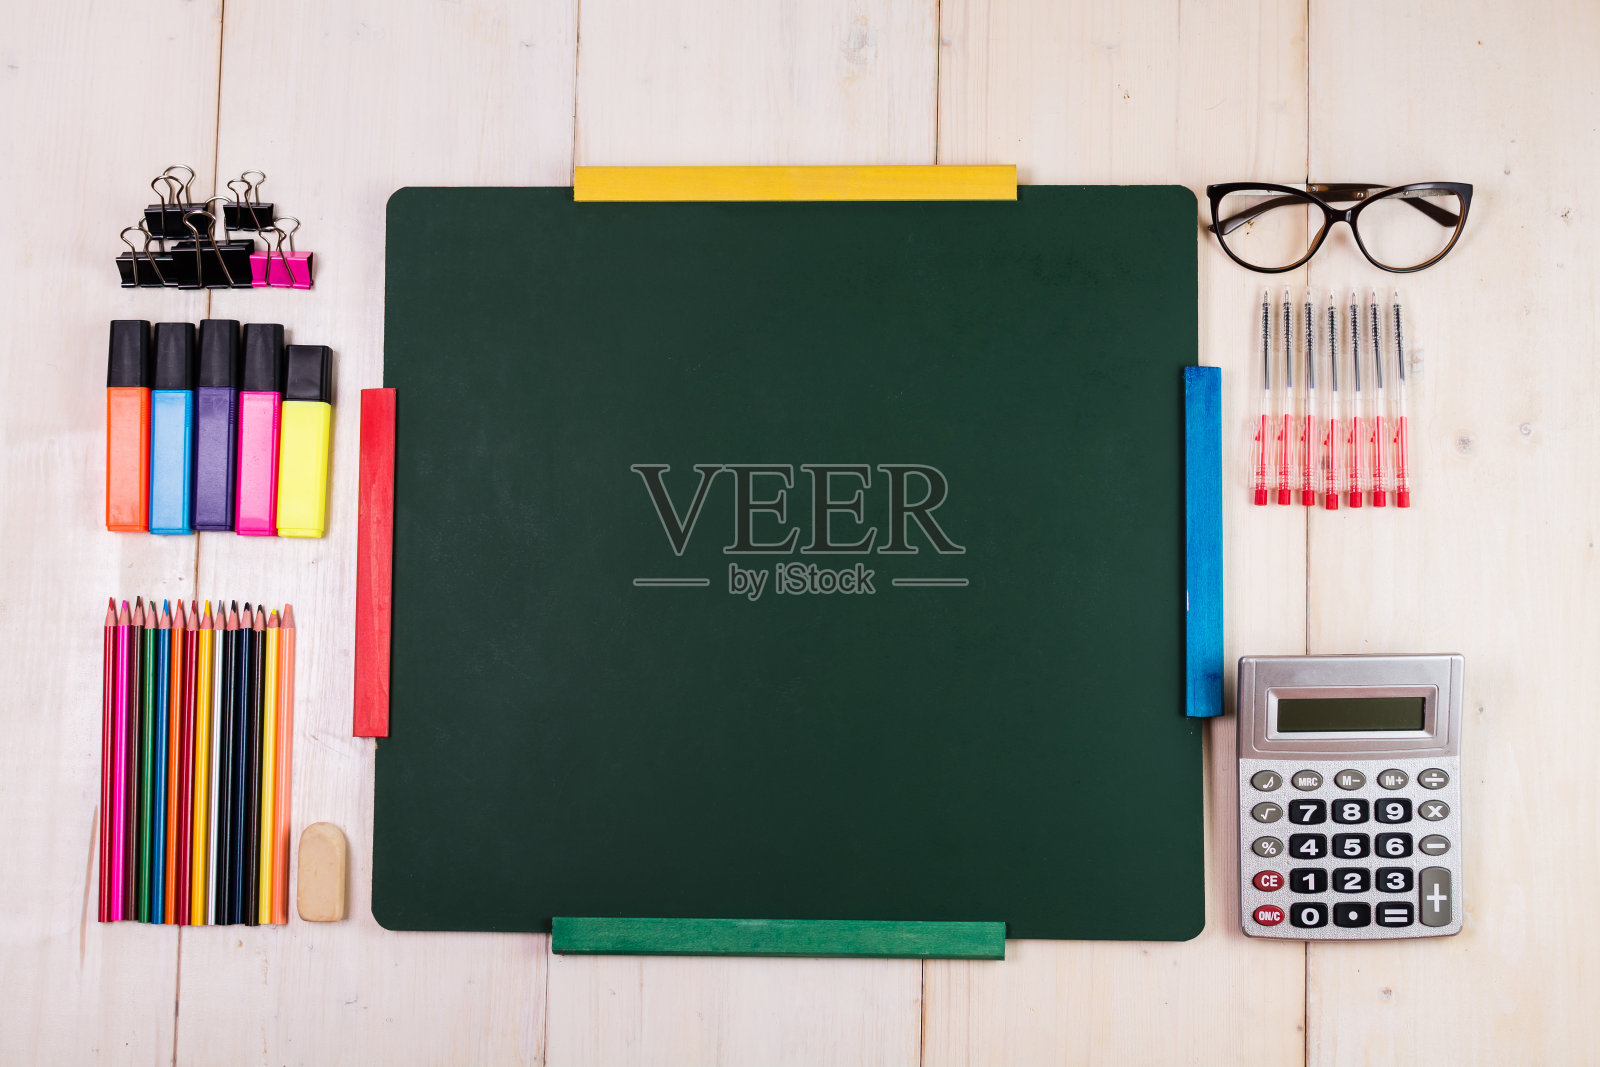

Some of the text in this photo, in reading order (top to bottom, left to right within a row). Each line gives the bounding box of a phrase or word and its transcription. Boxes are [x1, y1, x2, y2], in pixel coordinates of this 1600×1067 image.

[1299, 778, 1317, 786] MRC
[1386, 776, 1403, 785] M+
[1300, 805, 1317, 821] 7
[1343, 804, 1361, 820] 8
[1386, 803, 1403, 820] 9
[1300, 839, 1318, 855] 4
[1344, 839, 1361, 855] 5
[1386, 838, 1404, 855] 6
[1261, 875, 1277, 886] CE
[1303, 874, 1314, 890] 1
[1344, 873, 1361, 890] 2
[1387, 873, 1405, 889] 3
[1259, 911, 1280, 921] ON/C
[1302, 908, 1319, 925] 0
